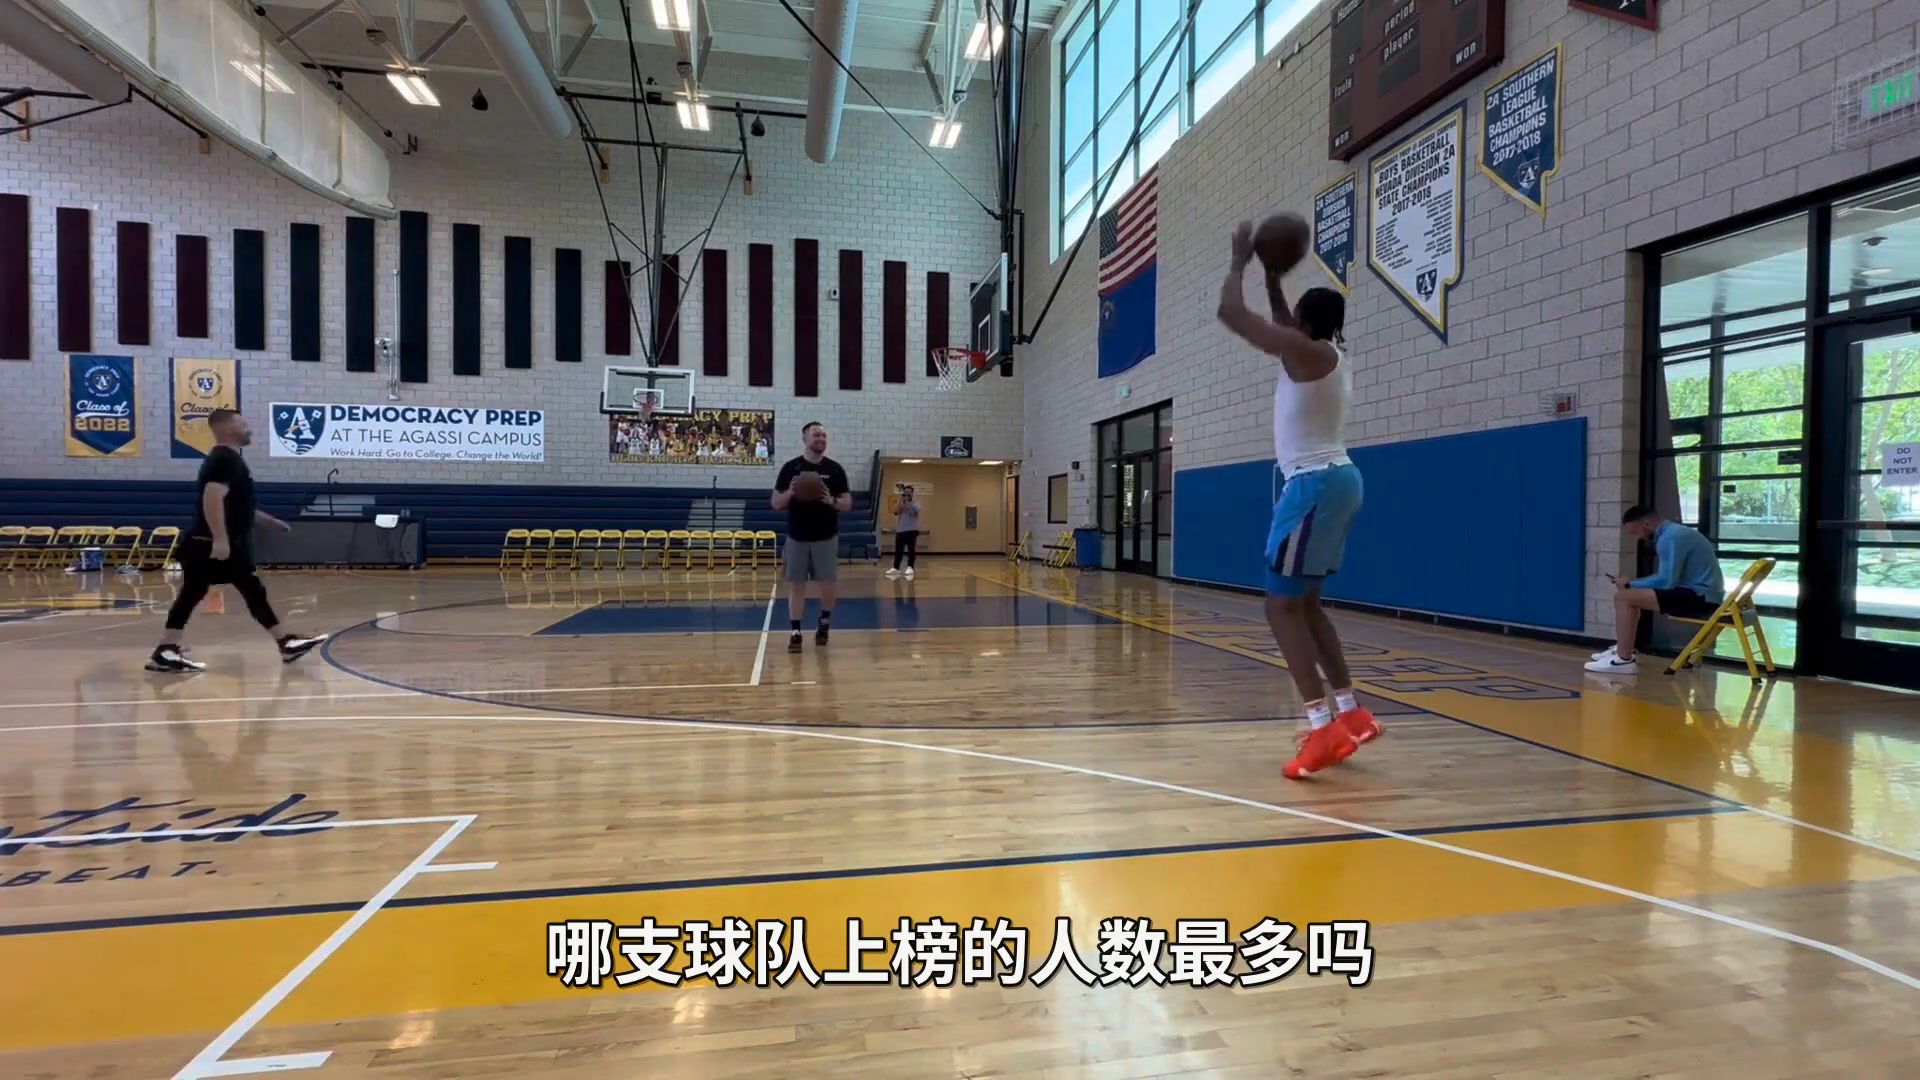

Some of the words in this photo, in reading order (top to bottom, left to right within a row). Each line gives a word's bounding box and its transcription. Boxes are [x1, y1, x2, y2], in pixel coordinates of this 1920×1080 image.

[1384, 0, 1415, 37] period
[1383, 27, 1414, 61] player
[1455, 41, 1477, 65] won
[1486, 91, 1499, 110] 2A
[1502, 58, 1555, 101] SOUTHERN
[1501, 85, 1537, 117] LEAGUE
[1488, 95, 1549, 139] BASKETBALL
[1489, 111, 1547, 153] CHAMPIONS
[1379, 162, 1399, 184] BOYS
[1401, 133, 1450, 172] BASKETBALL
[1492, 130, 1542, 166] 2017-2018
[1375, 174, 1402, 199] NEVADA
[1404, 152, 1441, 183] DIVISION
[1443, 143, 1456, 161] 2A
[1378, 189, 1400, 210] STATE
[1401, 161, 1450, 198] CHAMPIONS
[1392, 186, 1432, 217] 2017-2018
[76, 399, 111, 411] Class
[113, 401, 129, 416] of
[330, 405, 480, 425] DEMOCRACY
[485, 409, 542, 427] PREP
[728, 410, 773, 424] PREP
[75, 417, 130, 432] 2022
[330, 428, 353, 442] AT
[357, 428, 393, 443] THE
[399, 429, 462, 444] AGASSI
[467, 431, 542, 447] CAMPUS
[330, 448, 355, 457] Work
[358, 448, 383, 458] Hard.
[386, 449, 400, 458] Go
[403, 450, 413, 458] to
[415, 449, 453, 460] College.
[456, 450, 493, 461] Change
[495, 451, 510, 460] the
[1892, 457, 1912, 465] NOT
[1896, 447, 1911, 455] DO
[1886, 466, 1918, 475] ENTER
[0, 860, 218, 888] BEAT.
